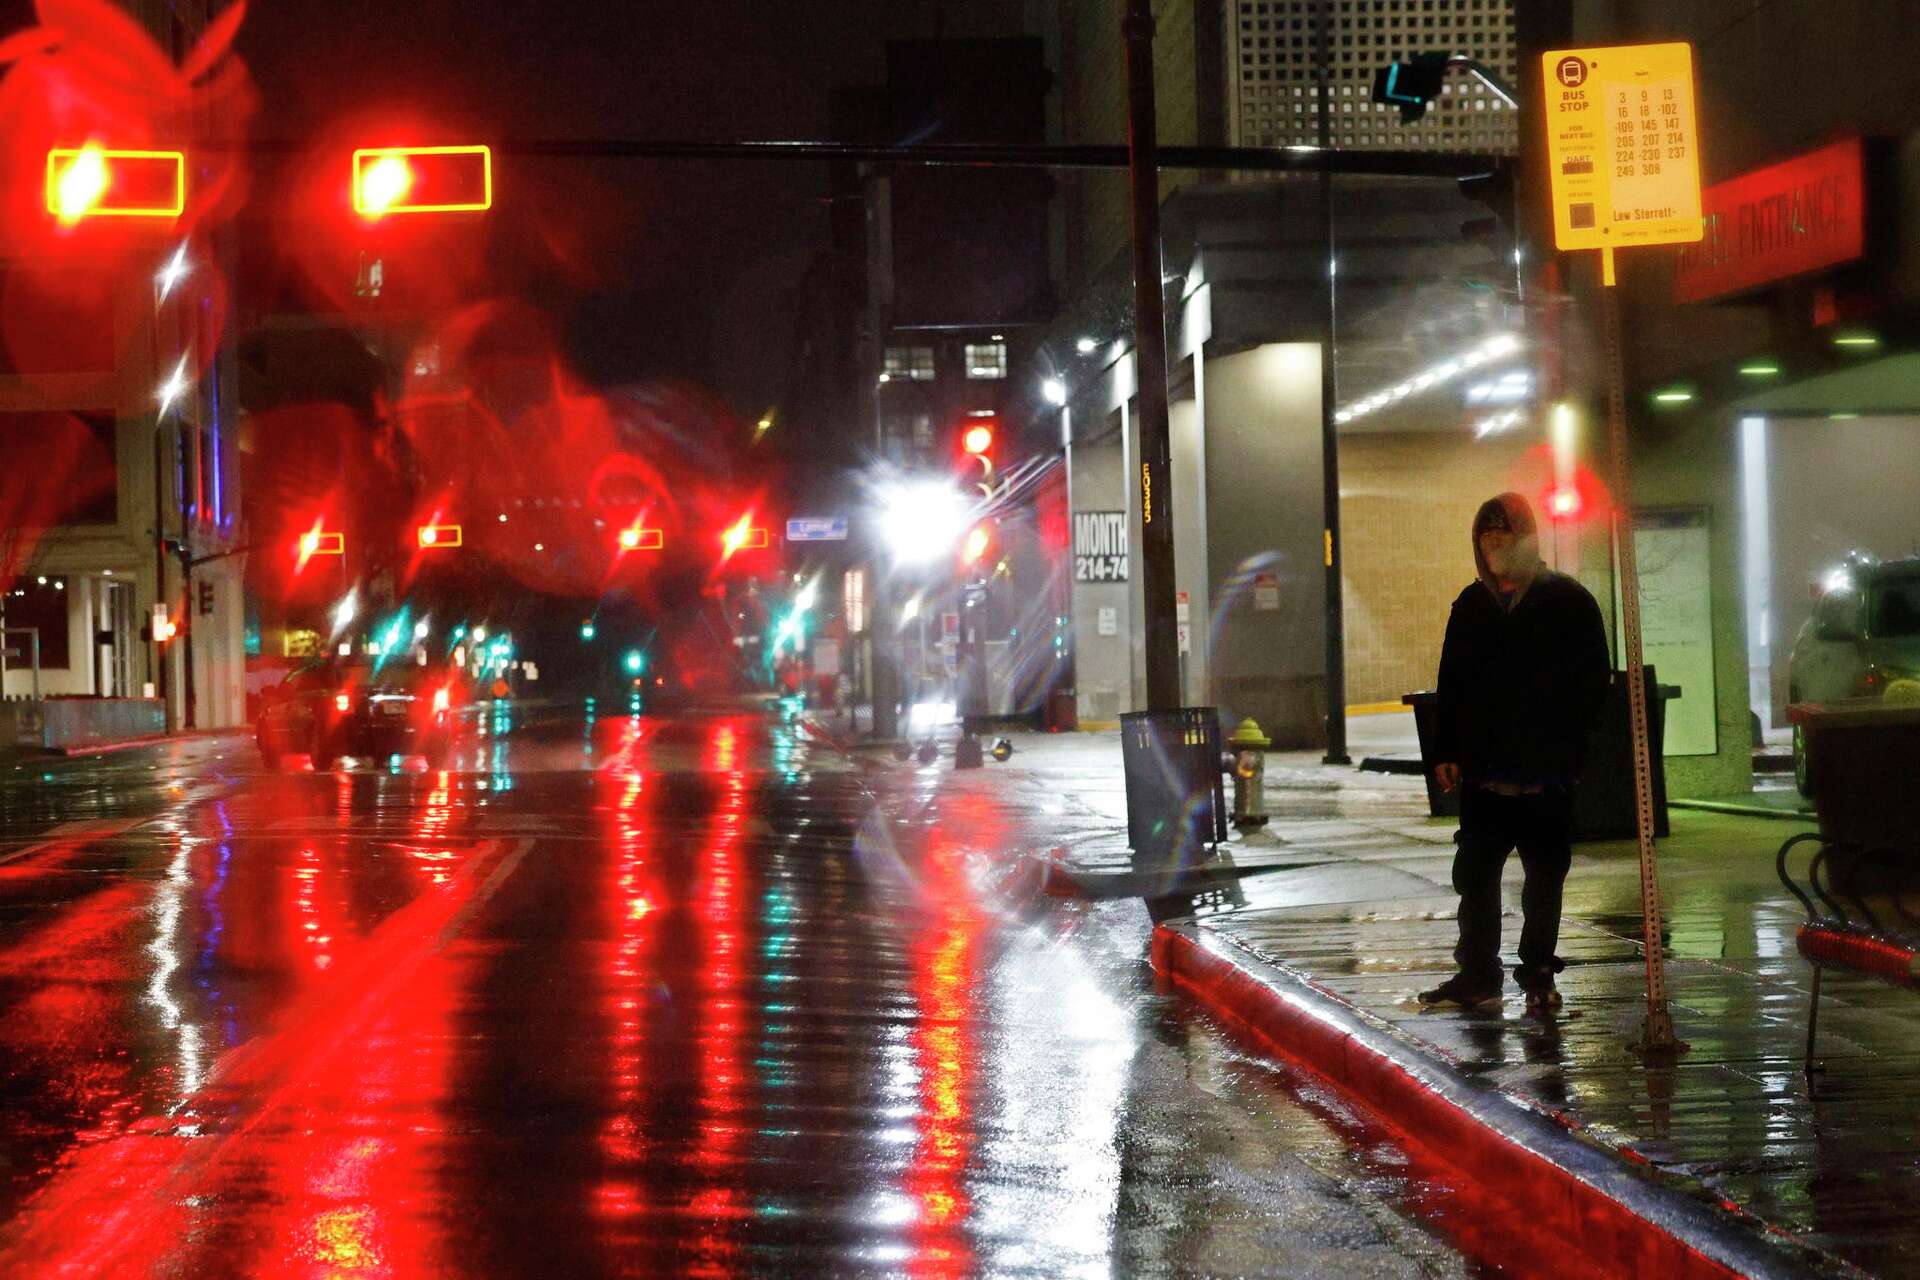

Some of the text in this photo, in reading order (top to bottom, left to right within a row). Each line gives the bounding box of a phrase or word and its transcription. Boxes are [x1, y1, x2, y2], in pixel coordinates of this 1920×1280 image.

[1562, 90, 1585, 100] BUS
[1619, 88, 1673, 103] 3 9 13
[1559, 102, 1589, 112] STOP
[1618, 106, 1628, 118] 16
[1639, 104, 1650, 117] 18
[1640, 119, 1657, 131] 145
[1665, 117, 1679, 129] 147
[1616, 132, 1683, 148] 205 207 214
[1616, 150, 1634, 163] 224
[1668, 146, 1685, 159] 237
[1616, 165, 1634, 178] 249
[1613, 210, 1631, 222] Lew
[1075, 512, 1129, 556] MONTH
[1076, 556, 1129, 580] 214-74
